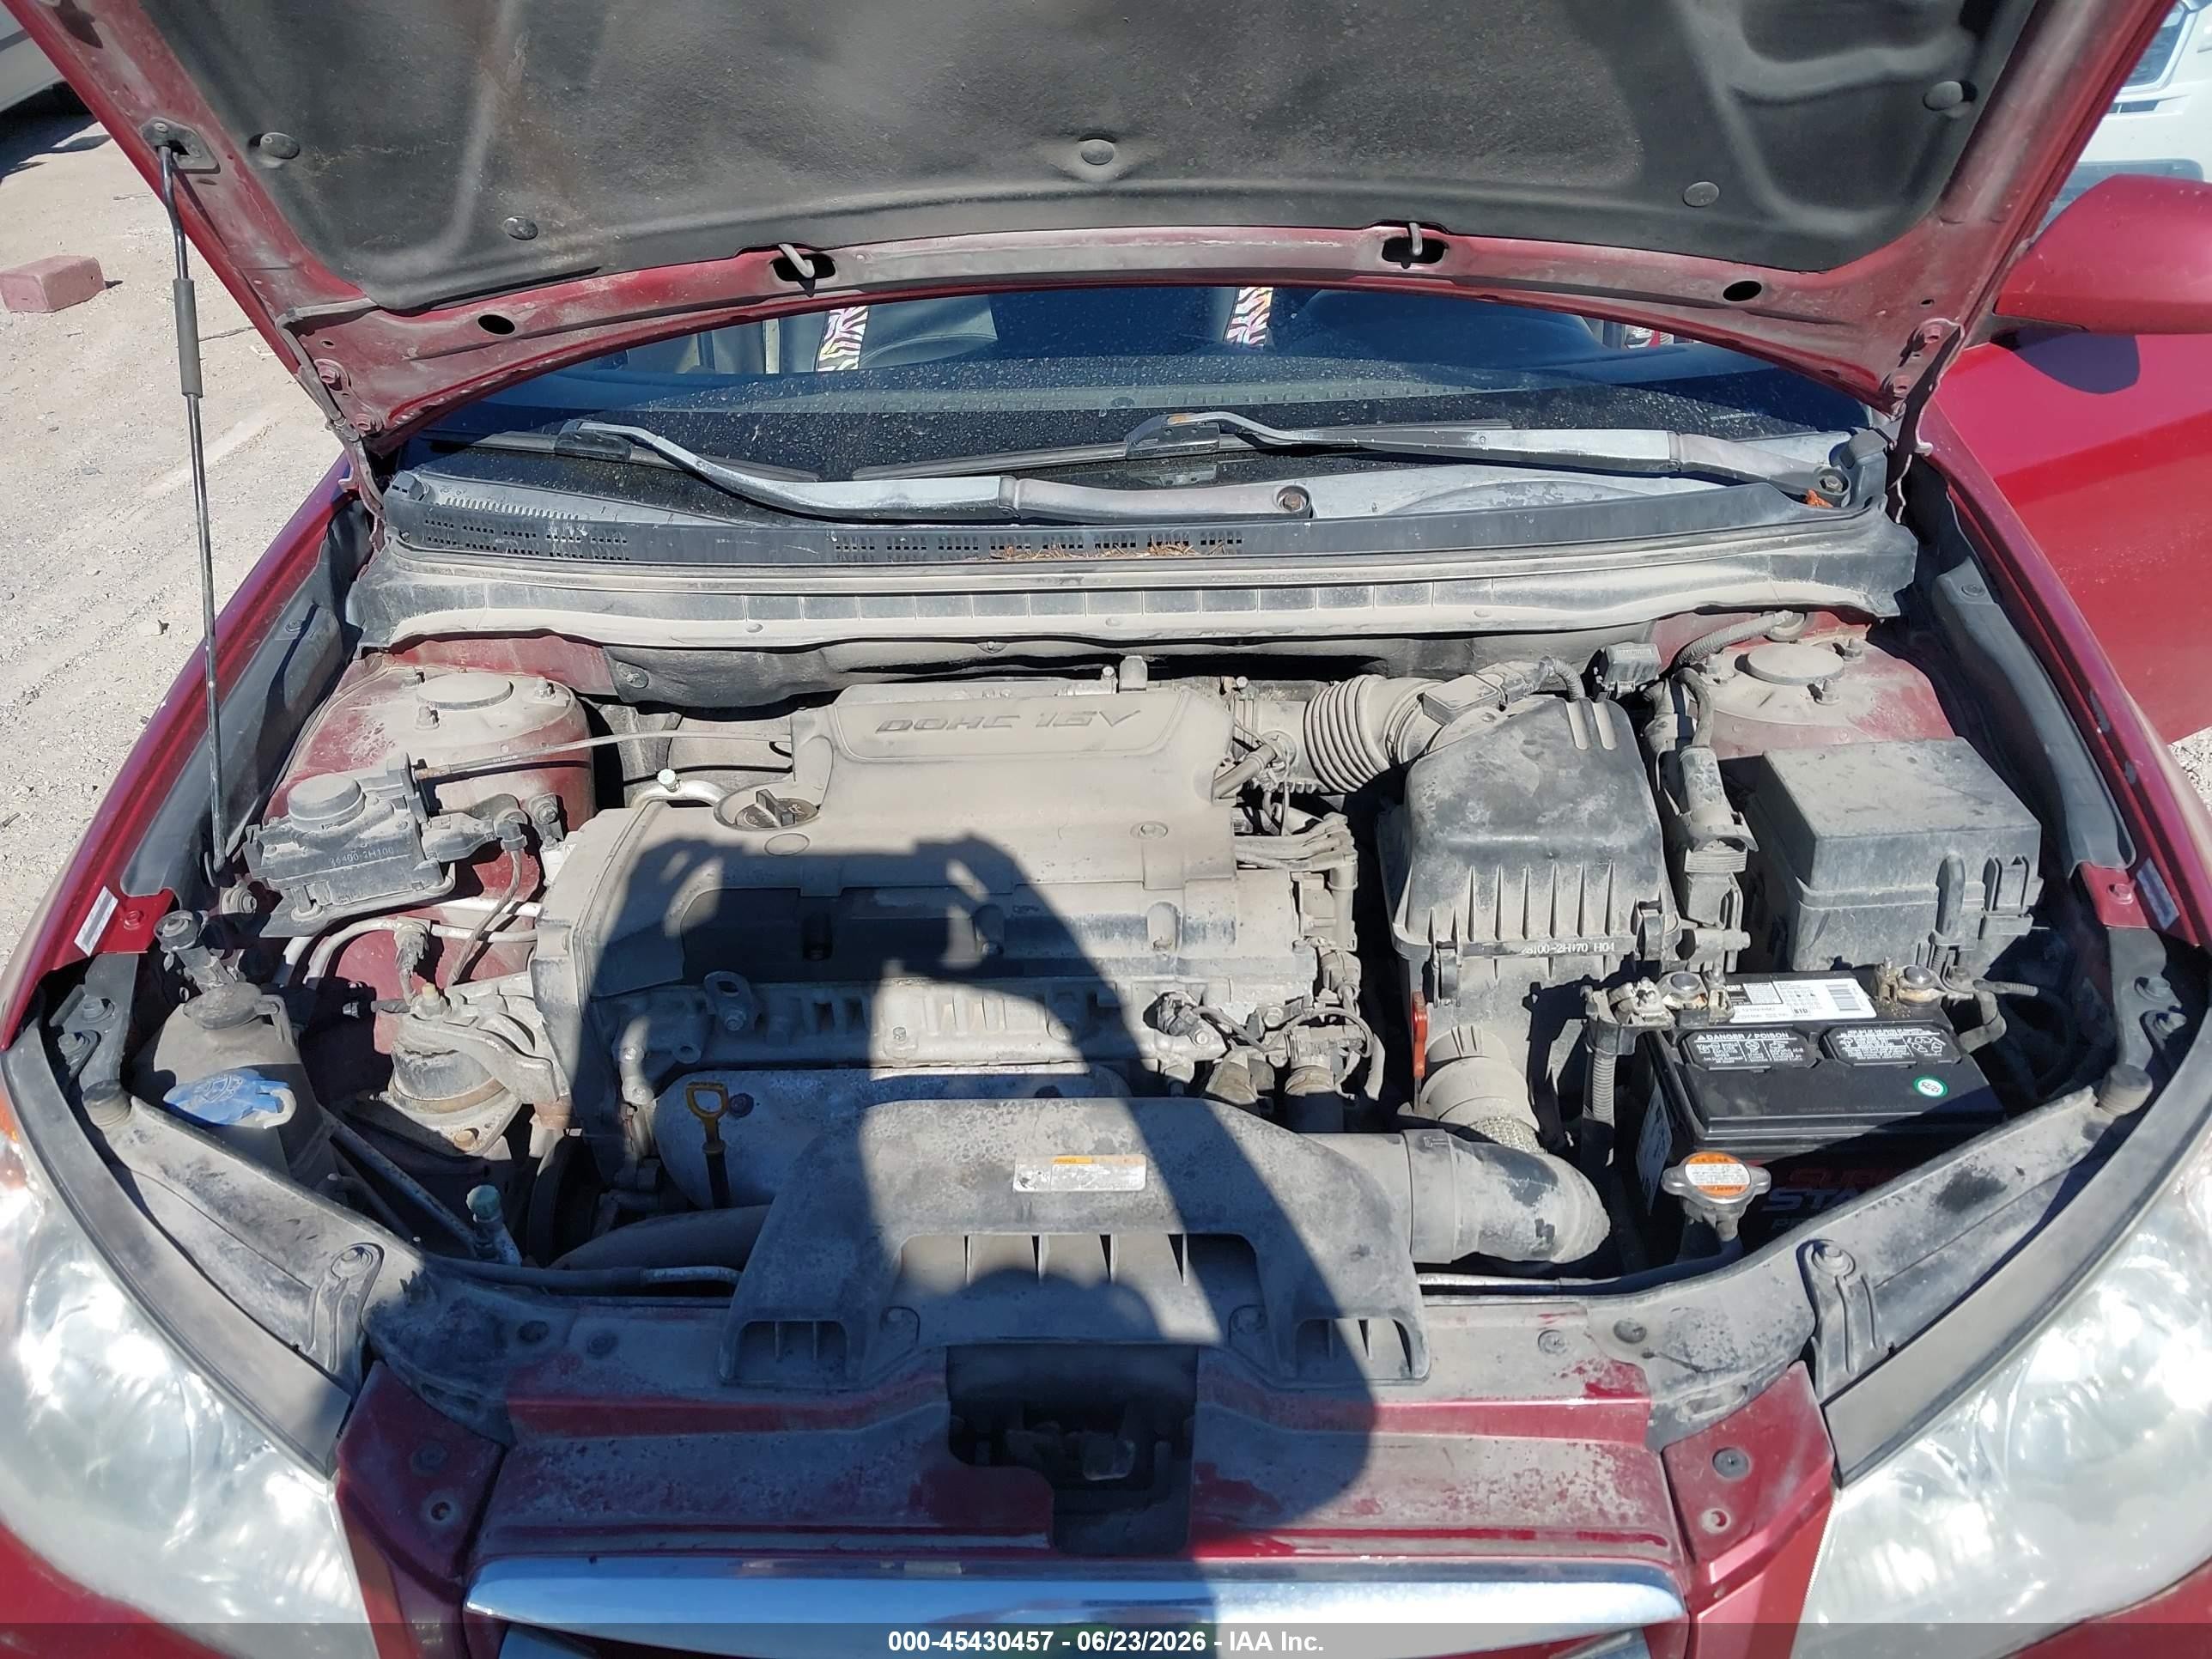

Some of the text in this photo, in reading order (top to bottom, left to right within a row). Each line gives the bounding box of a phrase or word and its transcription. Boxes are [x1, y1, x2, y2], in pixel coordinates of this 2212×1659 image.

[875, 709, 1141, 735] DOHC 16V
[1754, 1031, 1790, 1040] POISON
